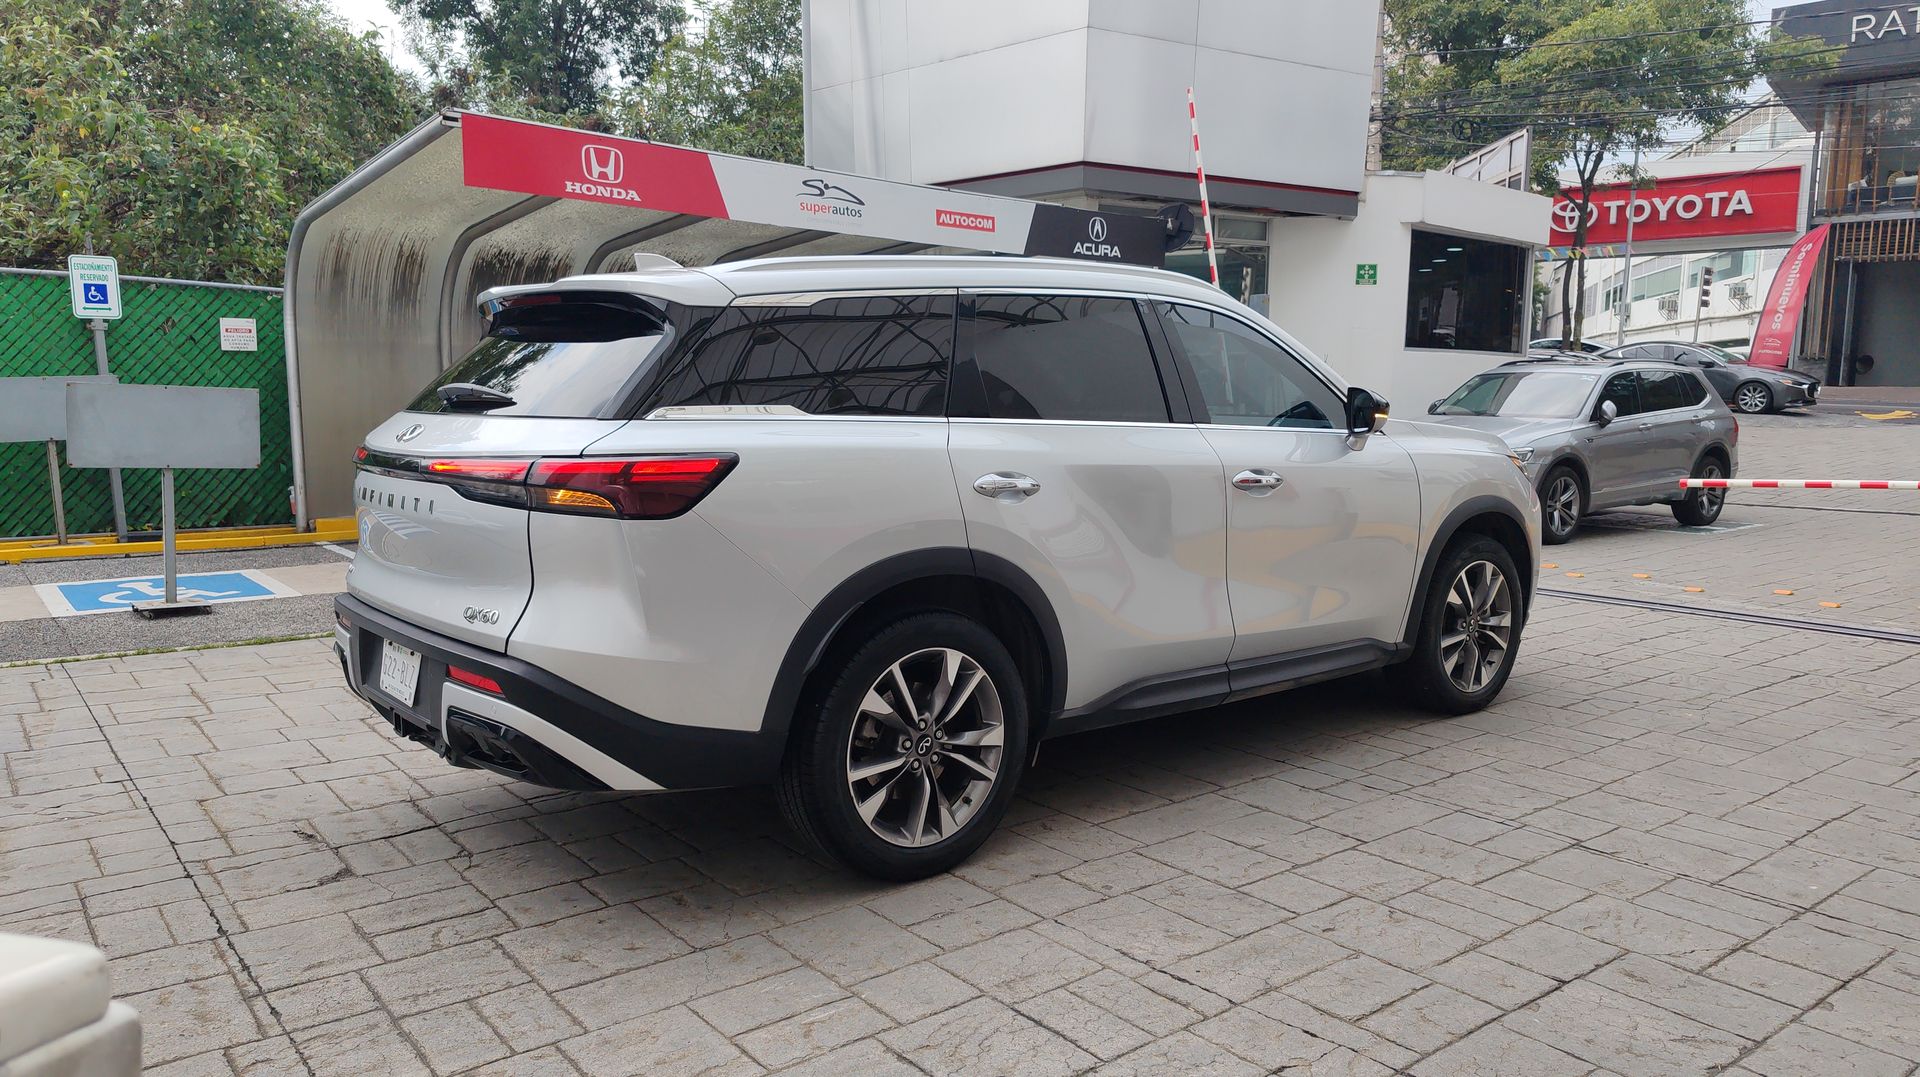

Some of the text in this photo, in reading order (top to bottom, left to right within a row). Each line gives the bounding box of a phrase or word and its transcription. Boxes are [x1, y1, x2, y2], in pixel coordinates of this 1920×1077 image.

[565, 181, 642, 201] HONDA
[800, 201, 862, 218] superautos
[1603, 189, 1753, 225] TOYOTA
[939, 213, 993, 229] AUTOCOM
[1073, 241, 1121, 258] ACURA
[80, 273, 109, 281] RESERVADO
[1771, 242, 1813, 330] Seminuevos
[358, 486, 434, 514] INFINITI
[463, 606, 500, 625] QX60
